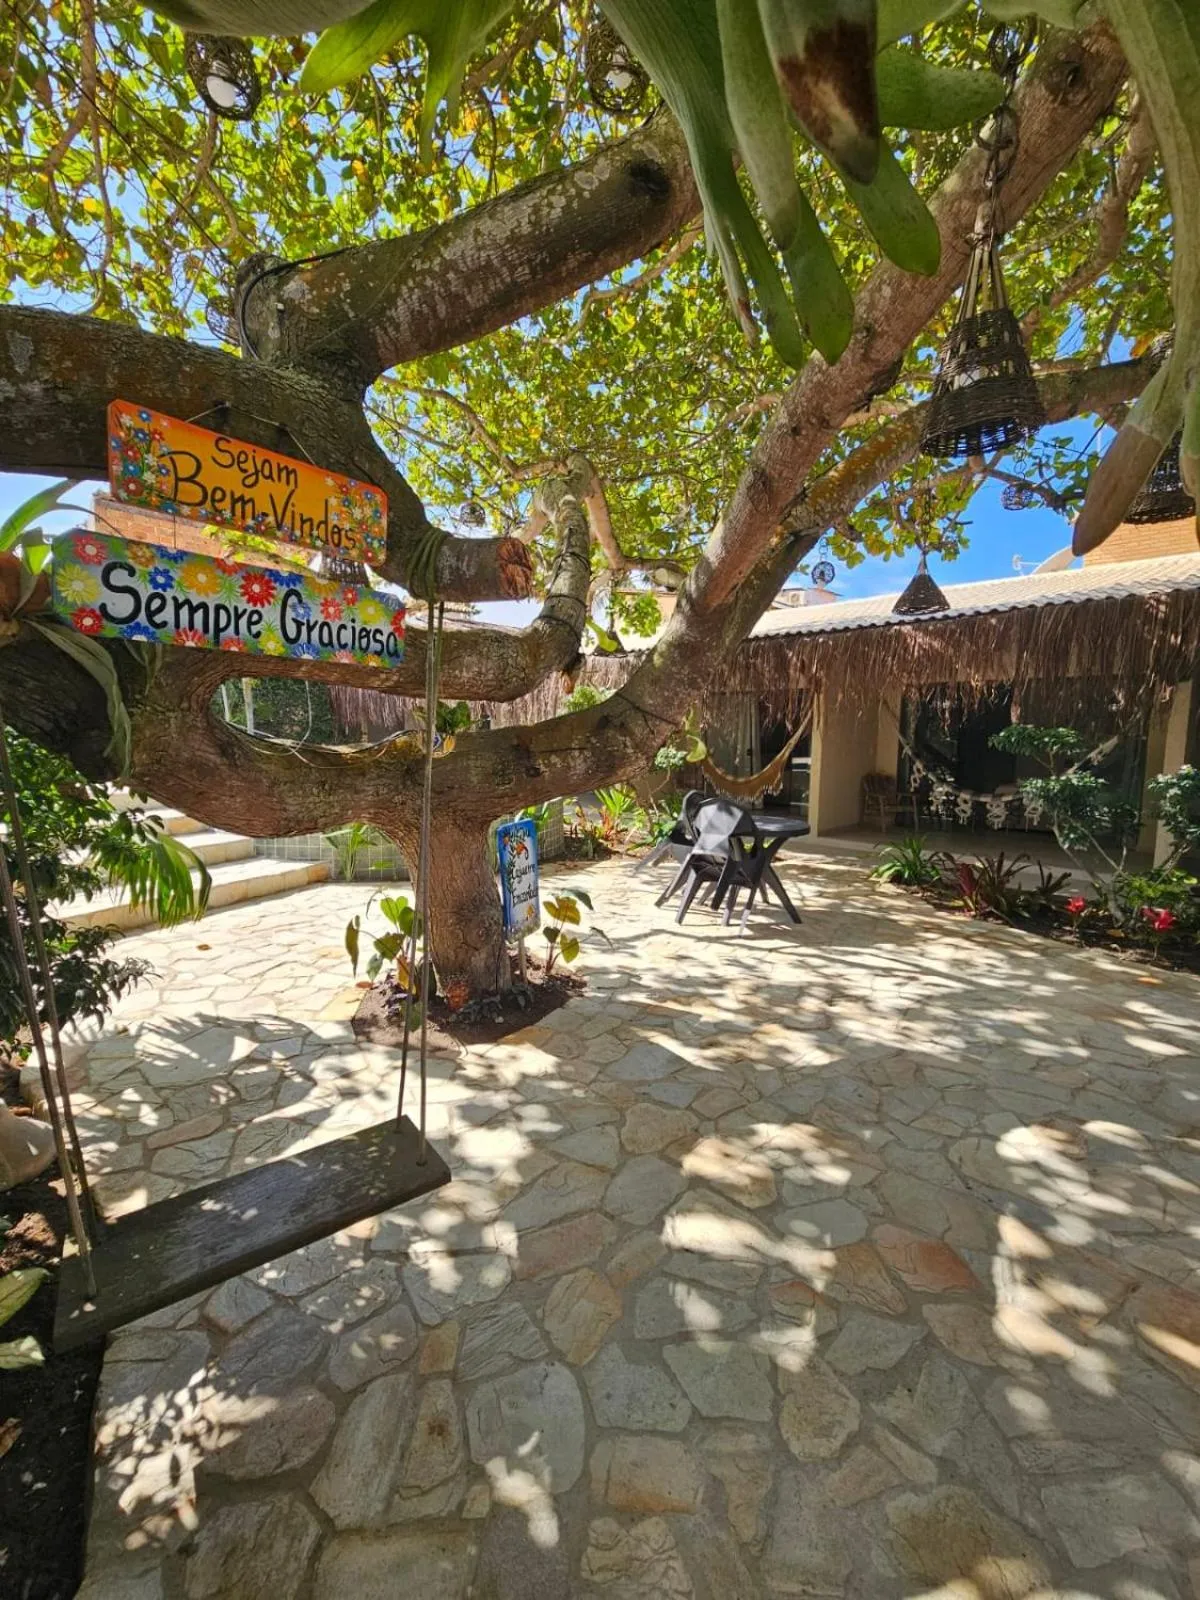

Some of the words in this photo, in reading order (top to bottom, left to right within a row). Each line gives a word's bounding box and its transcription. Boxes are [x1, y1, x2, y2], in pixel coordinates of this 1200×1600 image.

[212, 437, 299, 488] Sejam
[100, 561, 263, 645] Sempre
[280, 588, 399, 656] Graciosa
